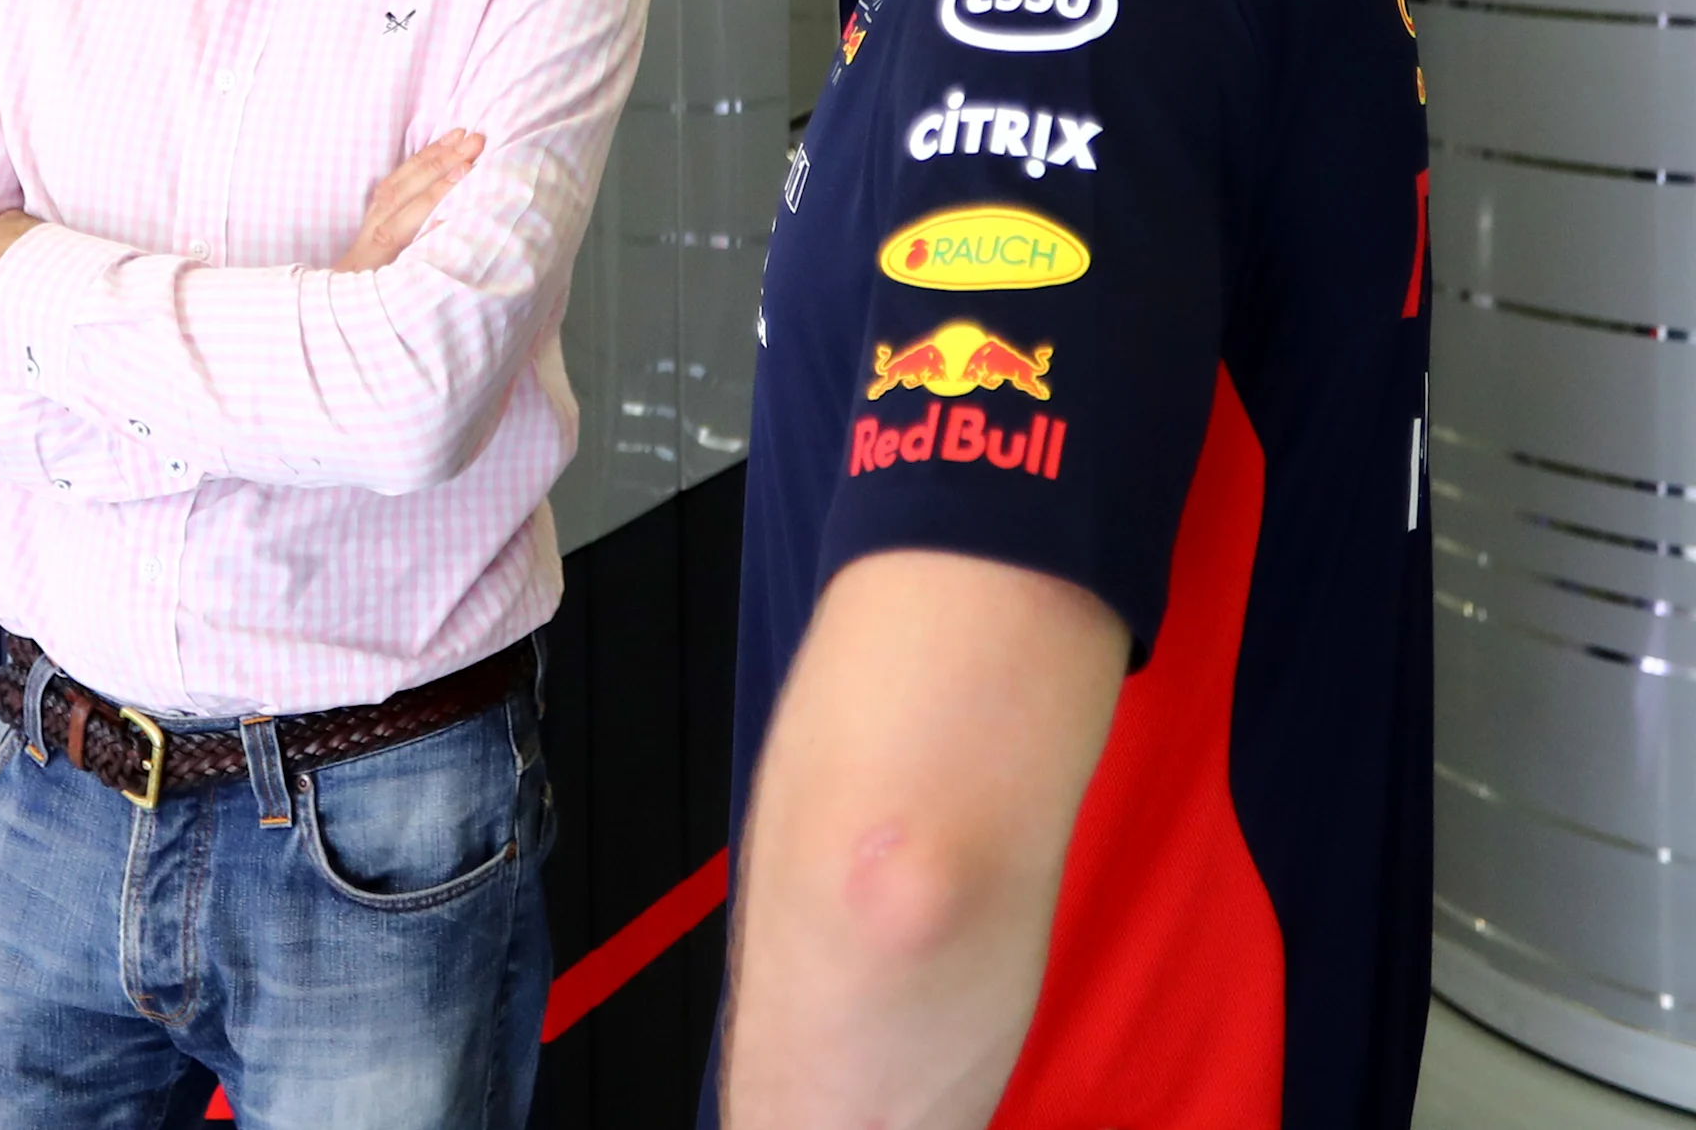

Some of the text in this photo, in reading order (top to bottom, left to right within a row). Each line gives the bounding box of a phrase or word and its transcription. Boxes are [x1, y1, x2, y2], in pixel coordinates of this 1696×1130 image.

[931, 234, 1058, 272] RAUCH
[849, 401, 1068, 481] Red Bull
